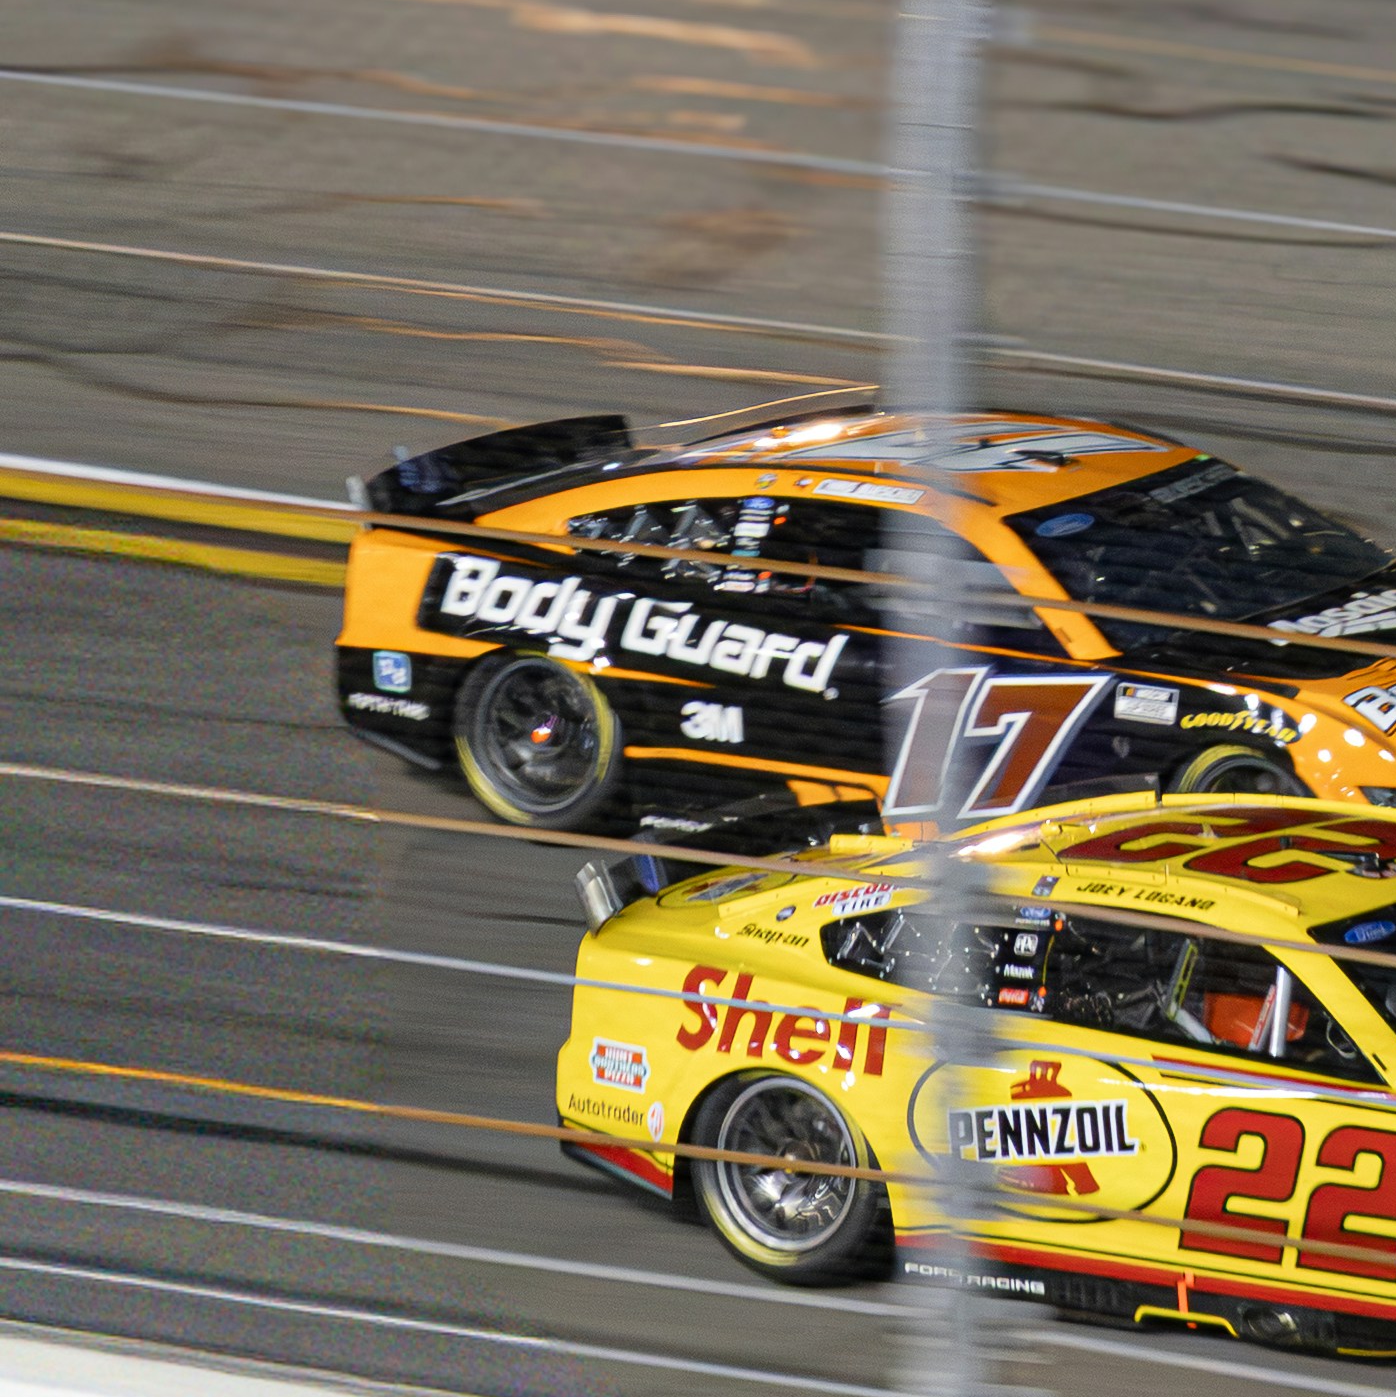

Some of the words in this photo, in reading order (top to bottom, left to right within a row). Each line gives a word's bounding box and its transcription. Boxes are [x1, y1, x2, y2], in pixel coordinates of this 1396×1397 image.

[440, 556, 617, 661] Body
[621, 596, 849, 693] Guard
[680, 700, 744, 743] 3M
[879, 666, 1113, 820] 17
[814, 883, 895, 907] DISCOU
[1077, 881, 1131, 897] JOEY
[1133, 888, 1217, 911] LOGANO
[676, 963, 892, 1076] Shell
[568, 1093, 645, 1126] Autotrader
[950, 1103, 1137, 1160] PENNZOIL
[967, 1274, 1046, 1296] RACING
